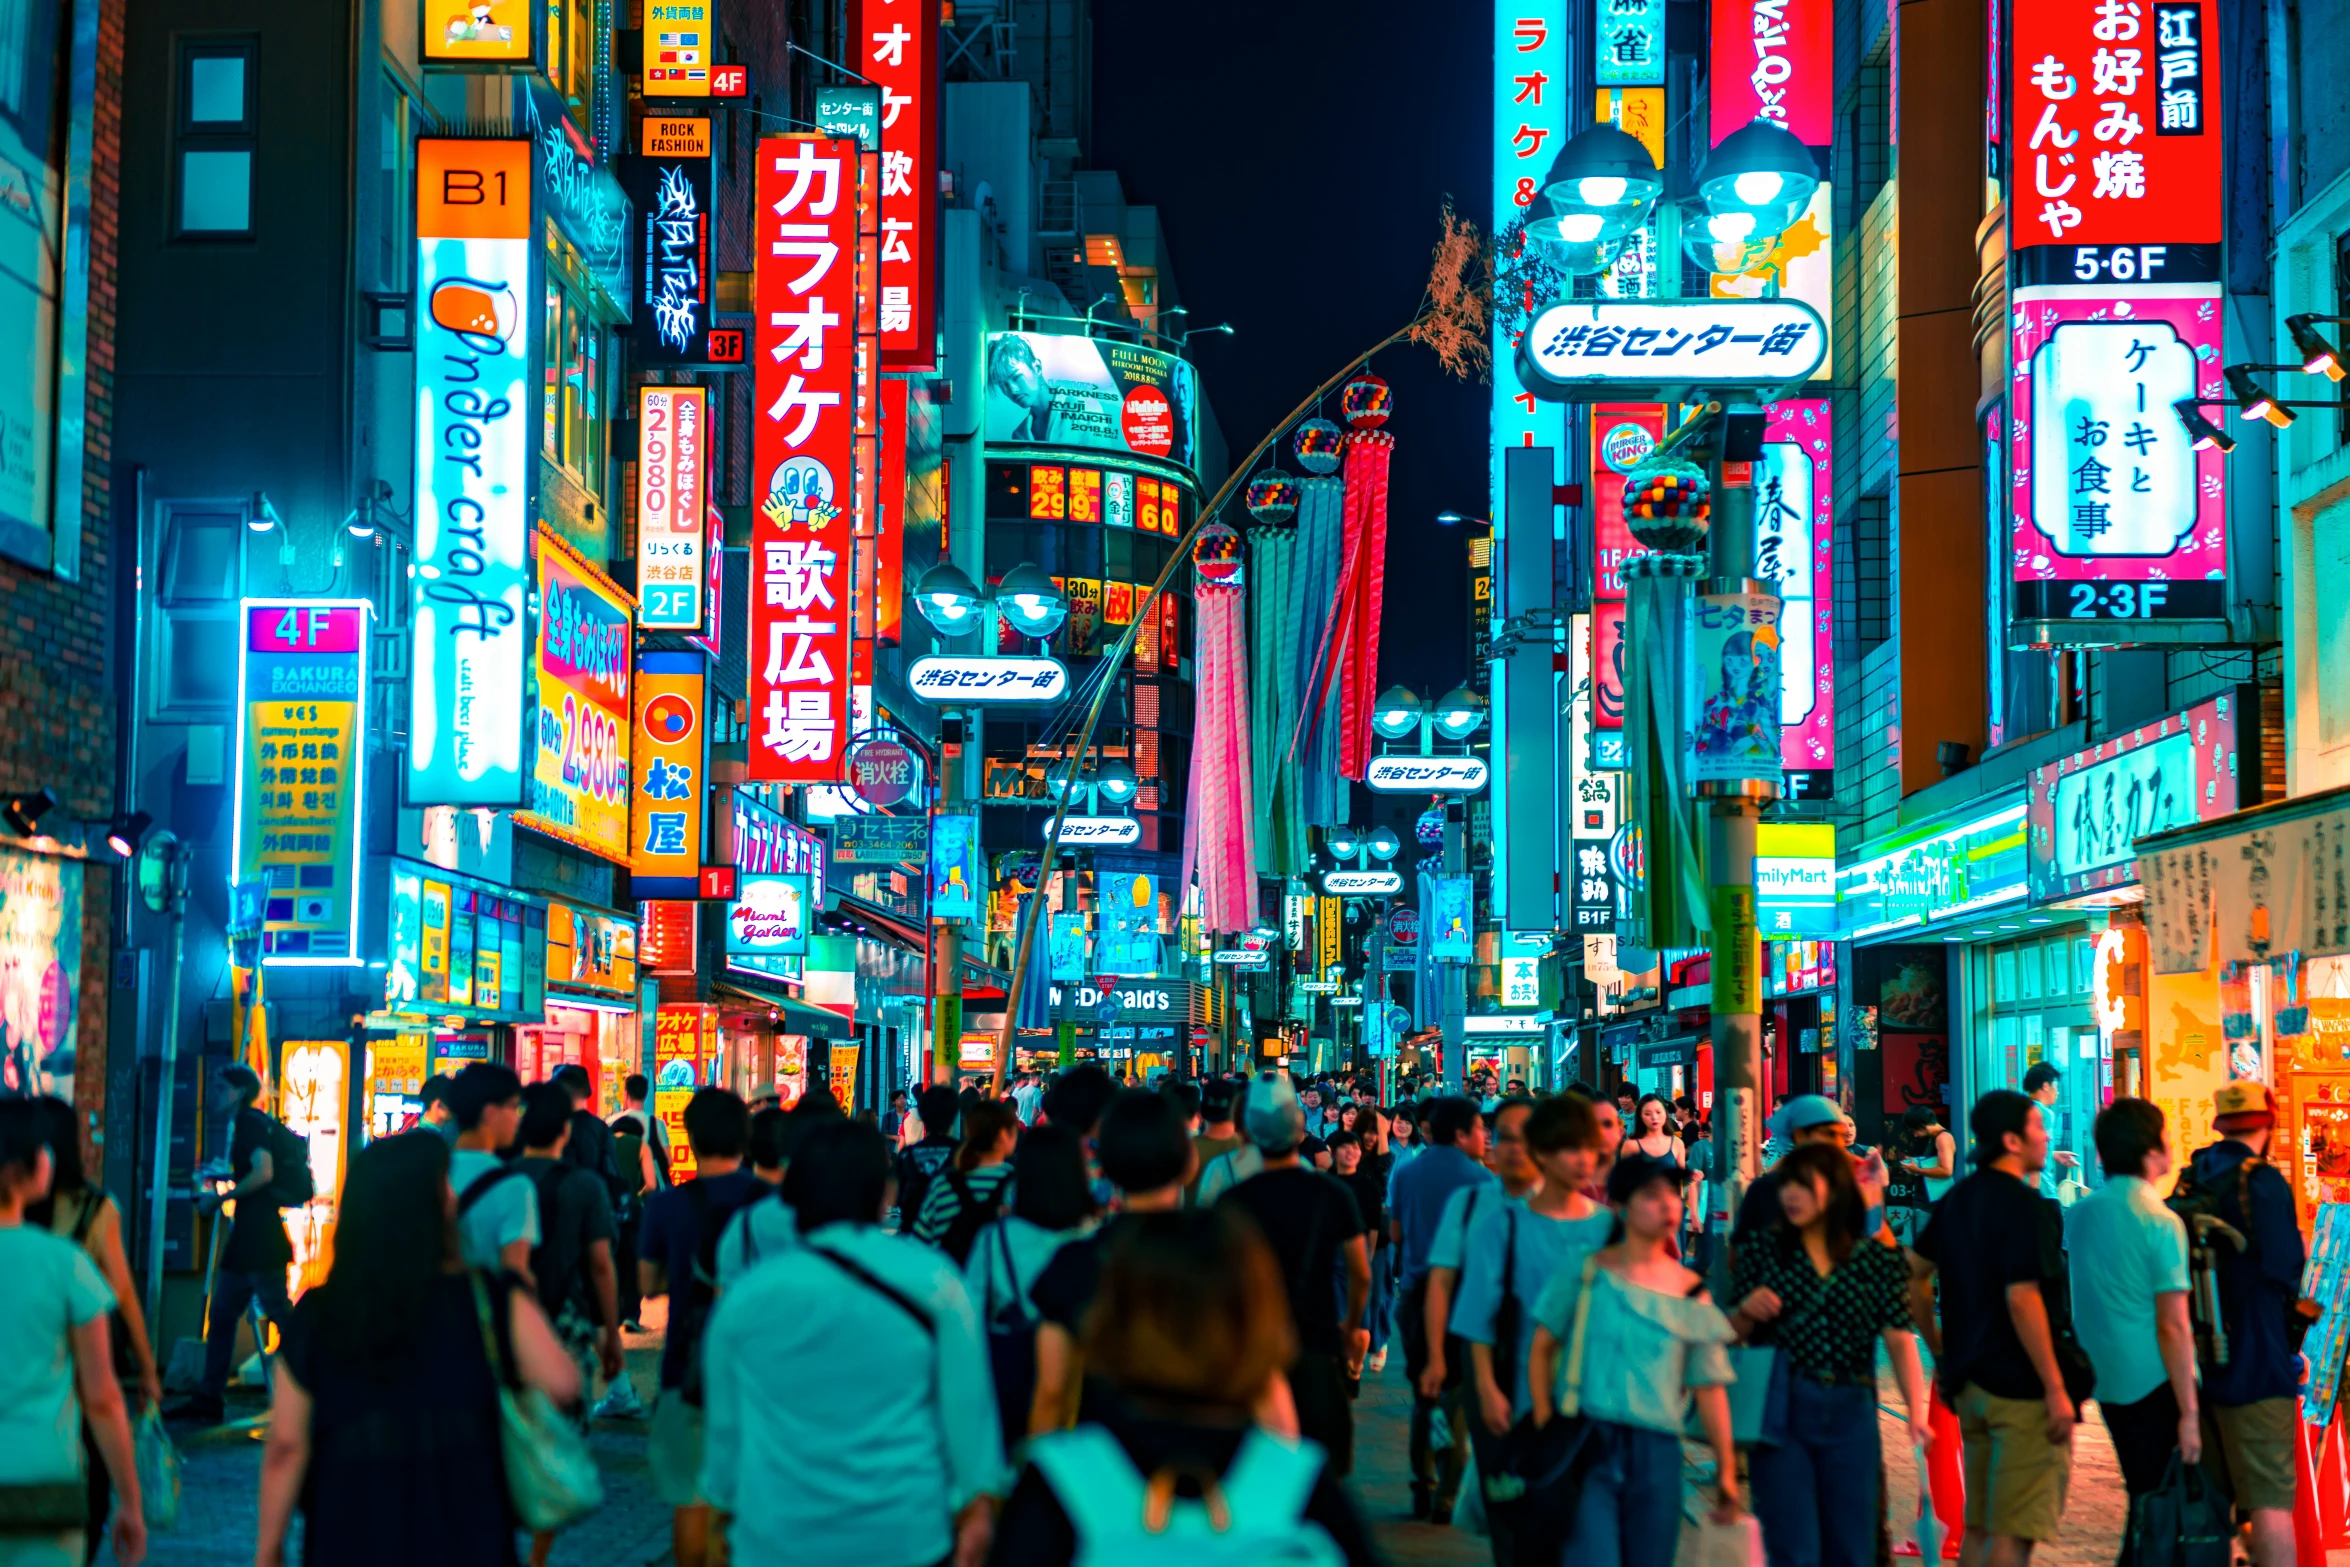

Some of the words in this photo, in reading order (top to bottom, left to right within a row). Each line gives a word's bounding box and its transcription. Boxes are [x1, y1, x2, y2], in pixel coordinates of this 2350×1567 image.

[652, 6, 704, 20] 外貨両替
[2159, 9, 2198, 130] 江戸前
[713, 72, 743, 92] 4F
[820, 102, 874, 116] センター街
[2091, 0, 2146, 200] お好み焼
[661, 123, 694, 136] ROCK
[651, 138, 704, 152] FASHION
[2028, 54, 2083, 239] もんじゃ
[443, 169, 507, 206] B1
[766, 142, 841, 449] カラオケ
[713, 335, 739, 357] 3F
[1543, 323, 1812, 358] 渋谷センター街
[1112, 349, 1140, 363] FULL
[1141, 354, 1168, 369] MOON
[1112, 360, 1144, 372] HIROOMI
[1145, 366, 1168, 378] TOSAKA
[1049, 387, 1119, 402] DARKNESS
[2123, 338, 2158, 493] ケーキと
[1070, 423, 1119, 435] 2018.8.1
[1610, 434, 1646, 453] BURGER
[676, 400, 696, 527] 全身もみほぐし
[1611, 444, 1648, 464] KING
[2071, 415, 2113, 539] お食事
[1122, 477, 1132, 523] やきとり
[647, 542, 693, 556] りらくる
[424, 497, 515, 641] craft
[646, 565, 694, 580] 渋谷店
[1069, 580, 1099, 599] 30分
[651, 591, 689, 616] 2F
[1069, 599, 1099, 616] 飲み
[1696, 598, 1746, 631] 七夕
[275, 607, 331, 646] 4F
[546, 577, 627, 699] 全身もみほぐし
[762, 539, 837, 764] 歌広場
[272, 666, 357, 681] SAKURA
[915, 669, 1060, 689] 渋谷センター街
[541, 708, 562, 755] 60分
[860, 749, 874, 757] FIRE
[875, 749, 904, 757] HYDRANT
[856, 760, 910, 786] 消火栓
[1374, 765, 1484, 781] 渋谷センター街
[1578, 778, 1611, 804] 鍋
[643, 757, 692, 856] 松屋
[859, 818, 928, 840] セキネ
[1047, 825, 1136, 836] 谷センター街
[851, 840, 918, 849] 03-3464-2061
[708, 871, 731, 896] 1F
[1327, 877, 1398, 888] 渋谷センター街
[730, 906, 787, 922] Miami
[1578, 911, 1611, 925] B1F
[1775, 911, 1792, 929] 酒
[1287, 920, 1301, 949] 牛タン
[449, 1044, 485, 1052] SAKURA
[656, 1032, 697, 1053] 広場
